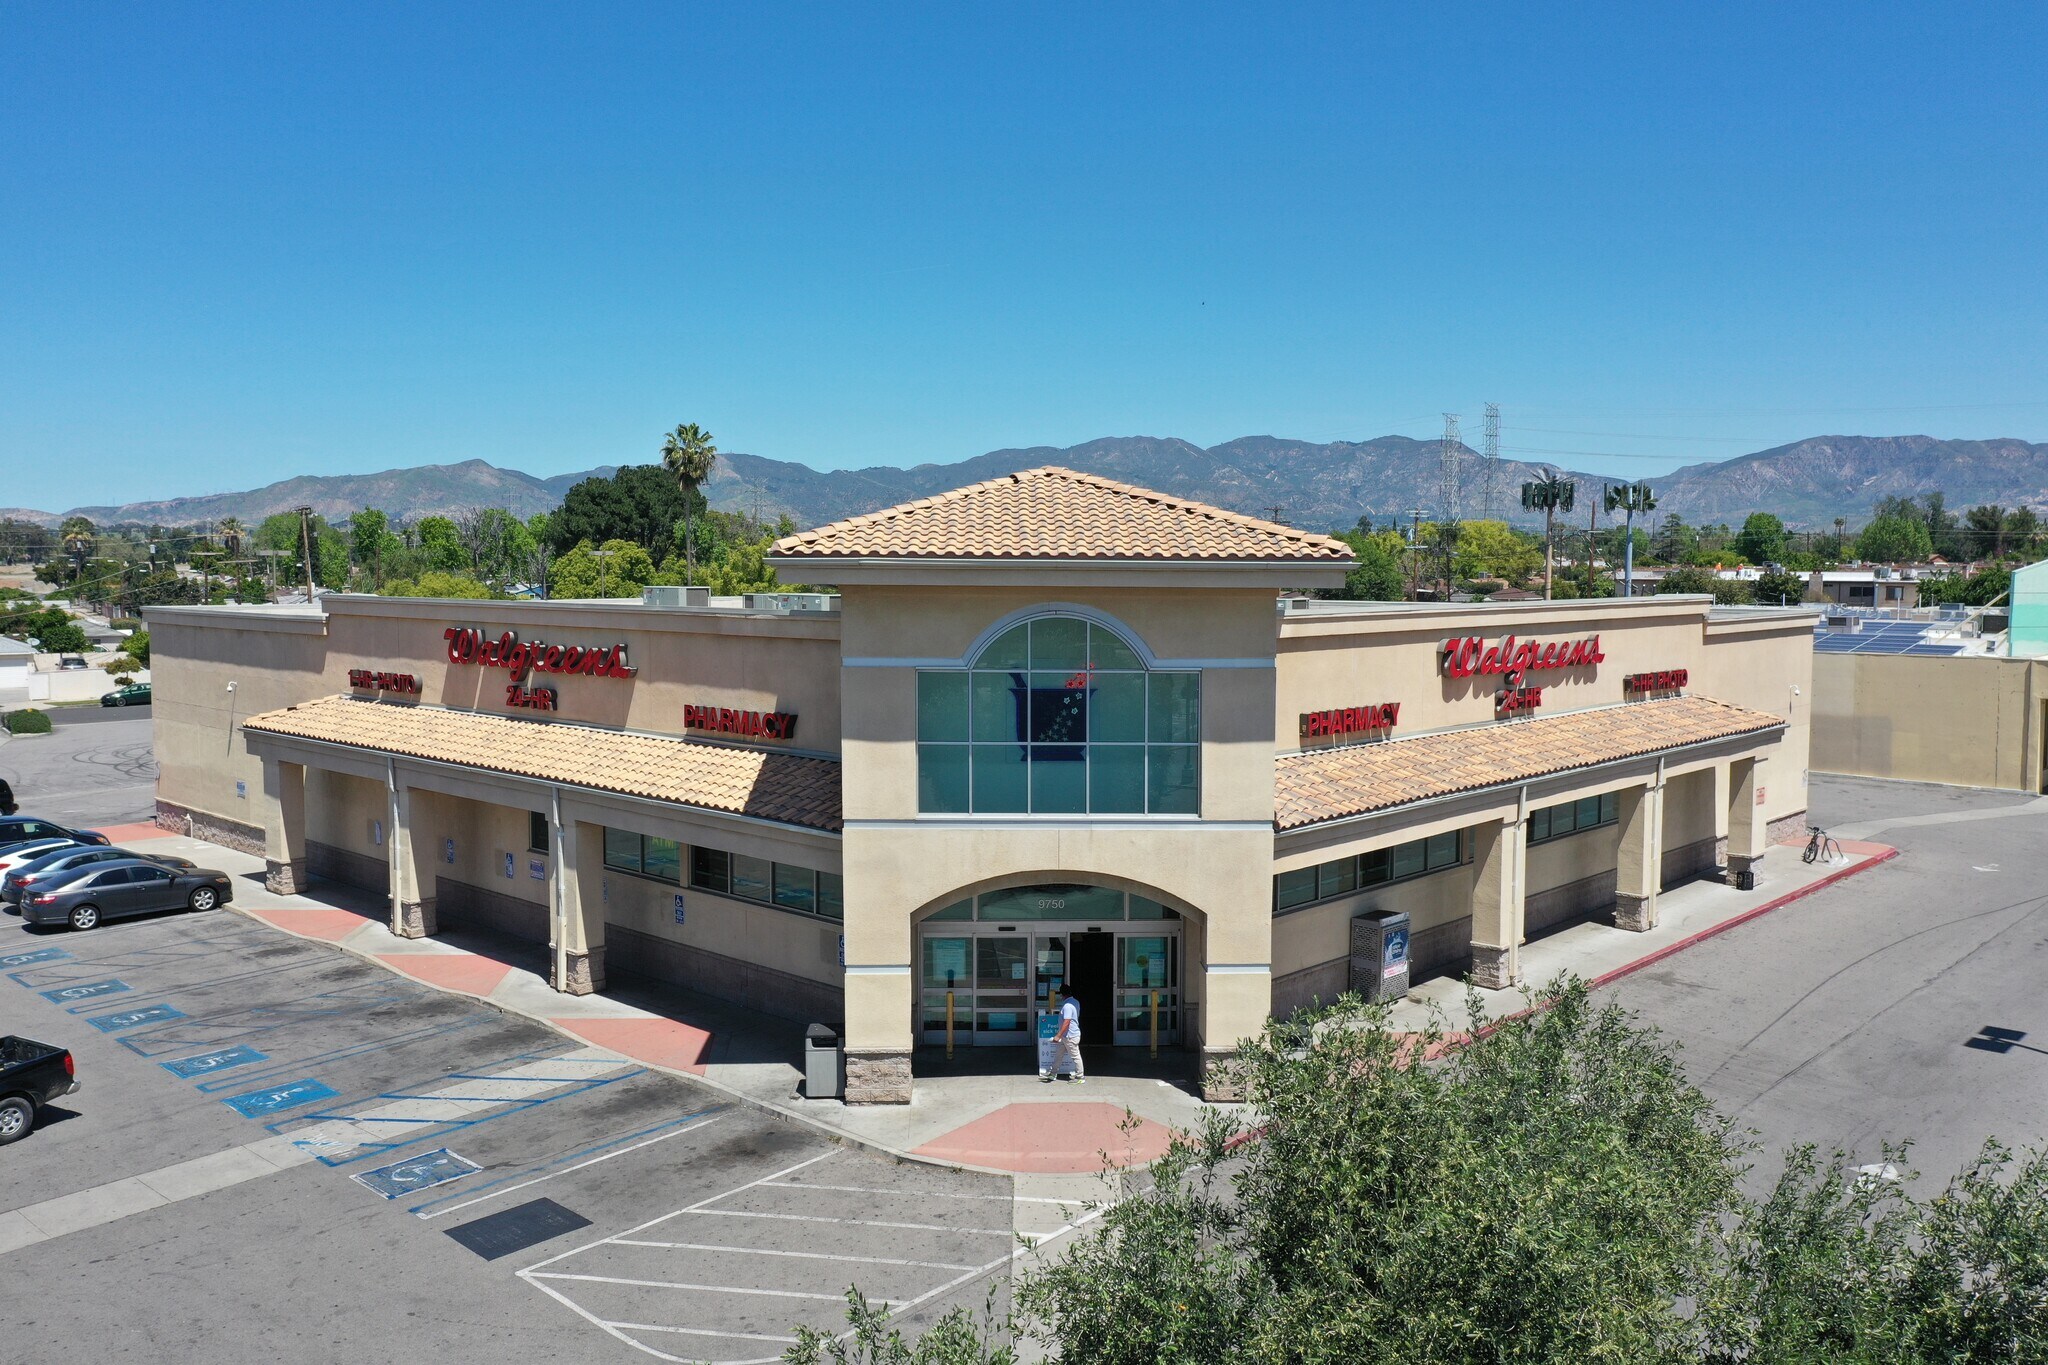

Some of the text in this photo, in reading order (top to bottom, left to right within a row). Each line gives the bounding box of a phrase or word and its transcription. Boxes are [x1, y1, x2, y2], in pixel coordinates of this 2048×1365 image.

[444, 627, 637, 682] Walgreens
[1440, 634, 1606, 686] Walgreens
[377, 672, 419, 695] PHOTO
[1657, 669, 1688, 690] PHOTO
[506, 685, 555, 711] 24-HR
[1500, 687, 1543, 713] 24-HR
[683, 704, 794, 740] PHARMACY
[1306, 703, 1401, 738] PHARMACY
[1038, 899, 1065, 909] 9750
